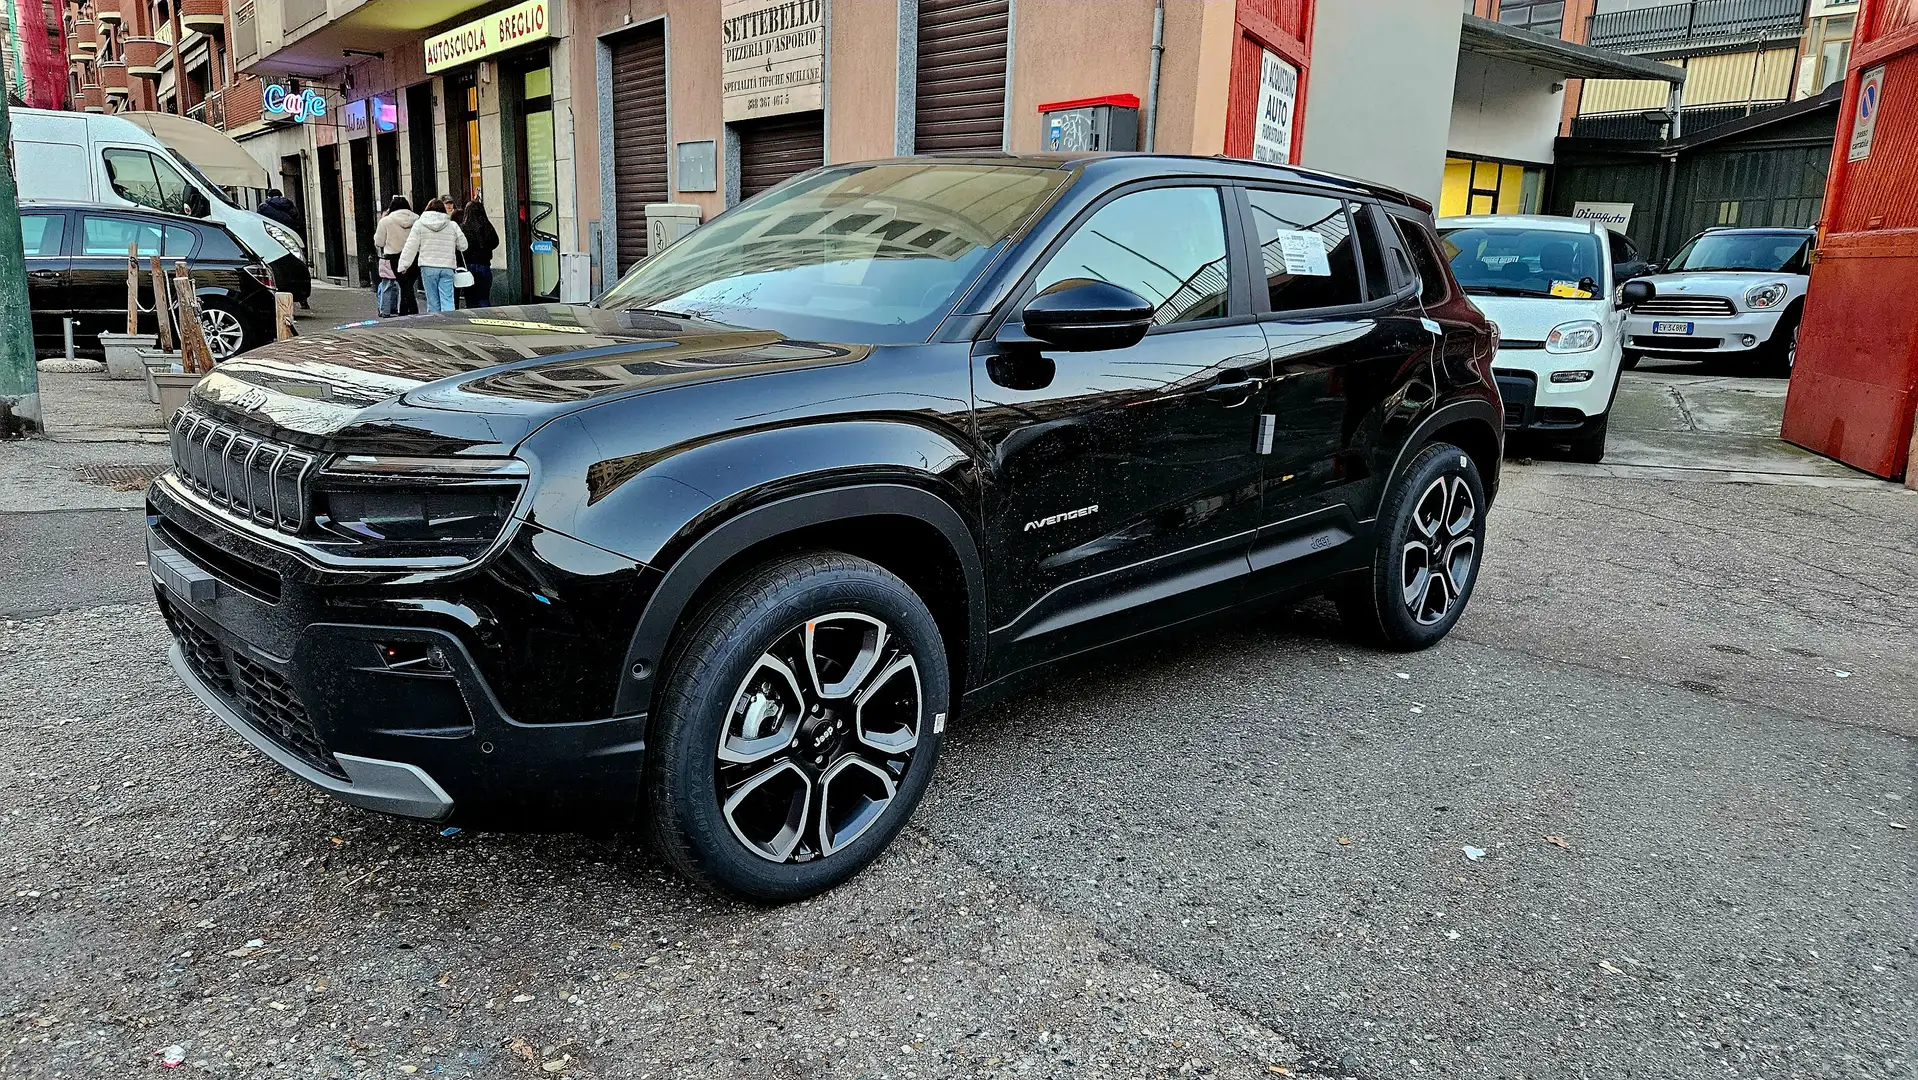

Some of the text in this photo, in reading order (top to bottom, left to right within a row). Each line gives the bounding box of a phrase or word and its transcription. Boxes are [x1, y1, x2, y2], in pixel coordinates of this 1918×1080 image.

[427, 4, 544, 66] AUTOSCUOLA BREGLIO
[723, 0, 820, 44] SETTEBELLO
[726, 30, 816, 63] PIZZERIA D'ASPORTO
[765, 57, 773, 73] &
[1262, 56, 1268, 85] SI
[723, 67, 820, 94] SPECIALITÀ TIPICHE SICILIANE
[263, 84, 327, 123] Cafe
[1265, 94, 1288, 127] AUTO
[230, 387, 268, 414] Jeep
[1023, 504, 1099, 532] AVENGER
[1310, 535, 1331, 550] Jeep
[813, 726, 834, 748] Jeep
